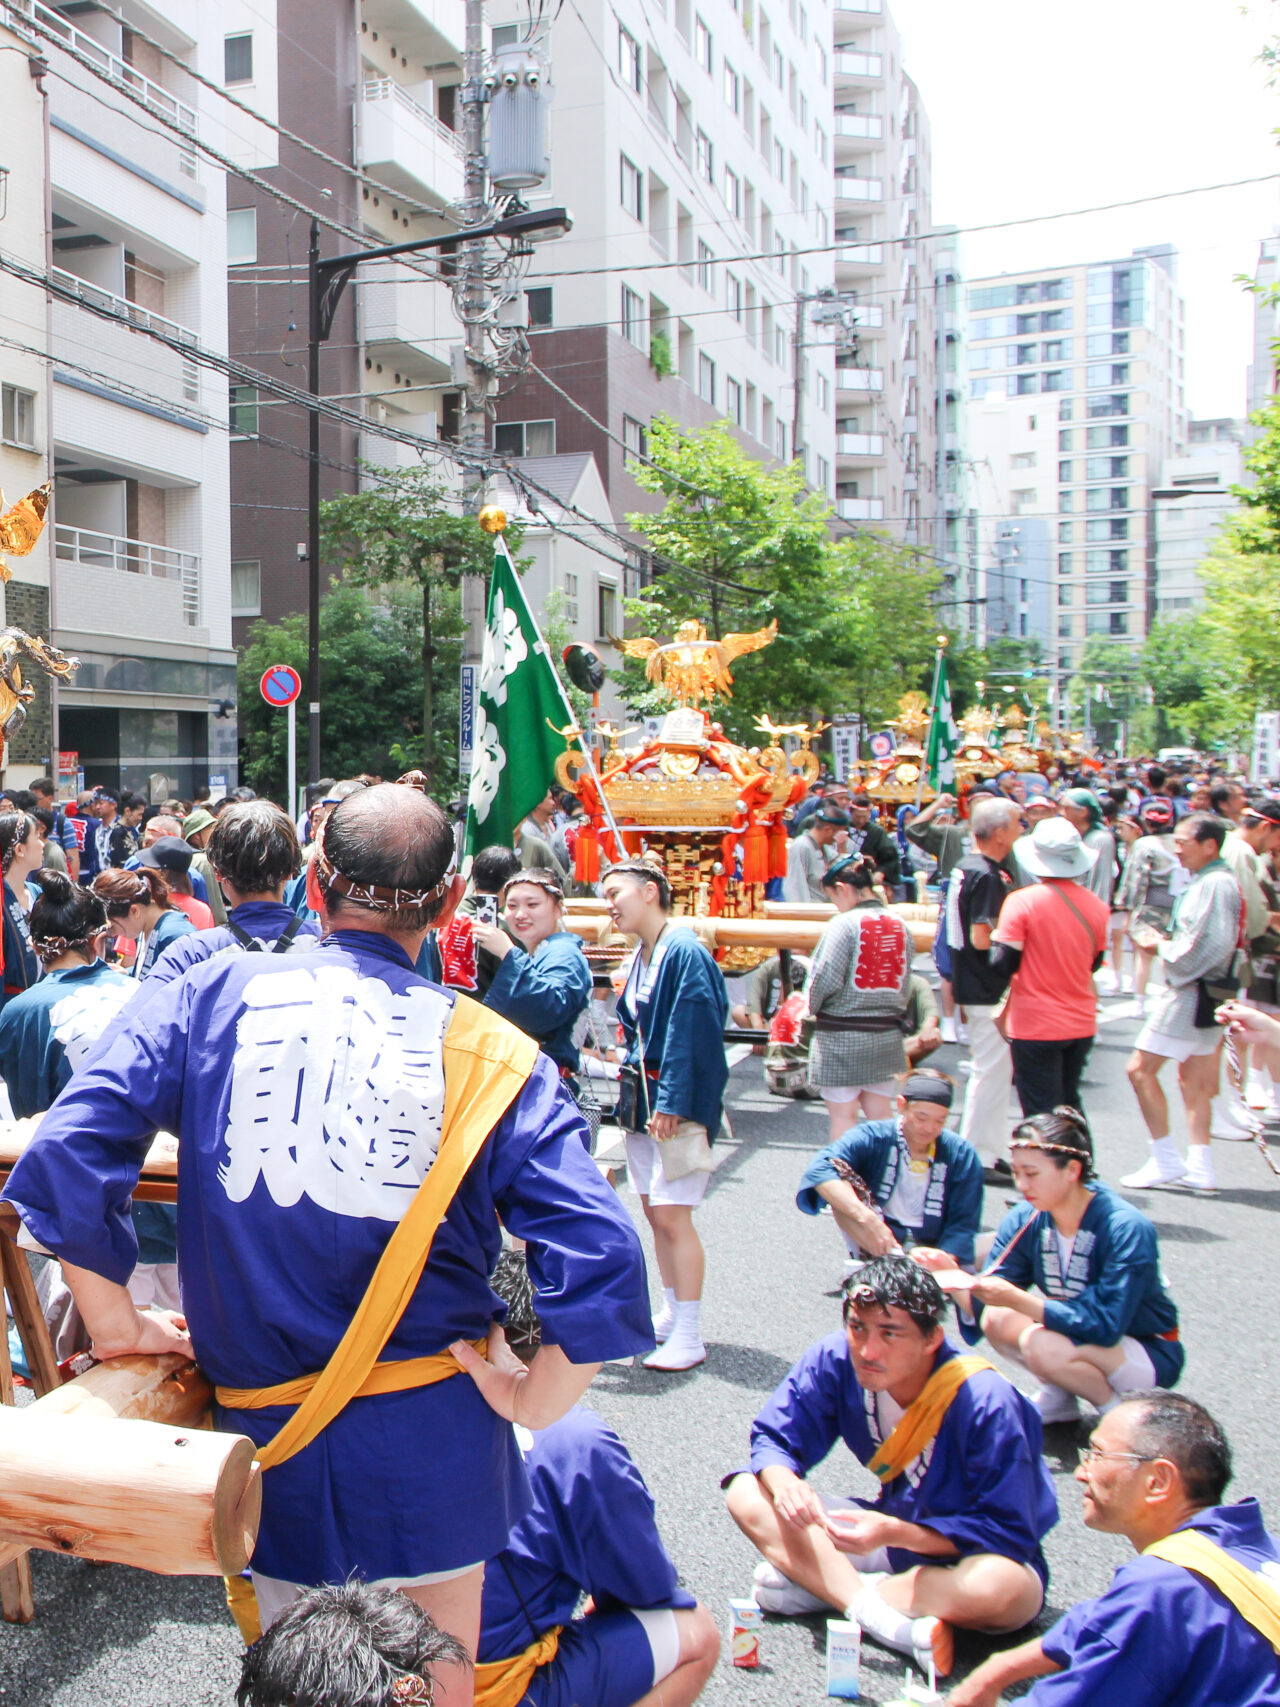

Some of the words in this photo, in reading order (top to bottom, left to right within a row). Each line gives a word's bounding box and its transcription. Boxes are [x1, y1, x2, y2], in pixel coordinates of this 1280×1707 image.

[462, 668, 472, 750] 新川トランクルーム
